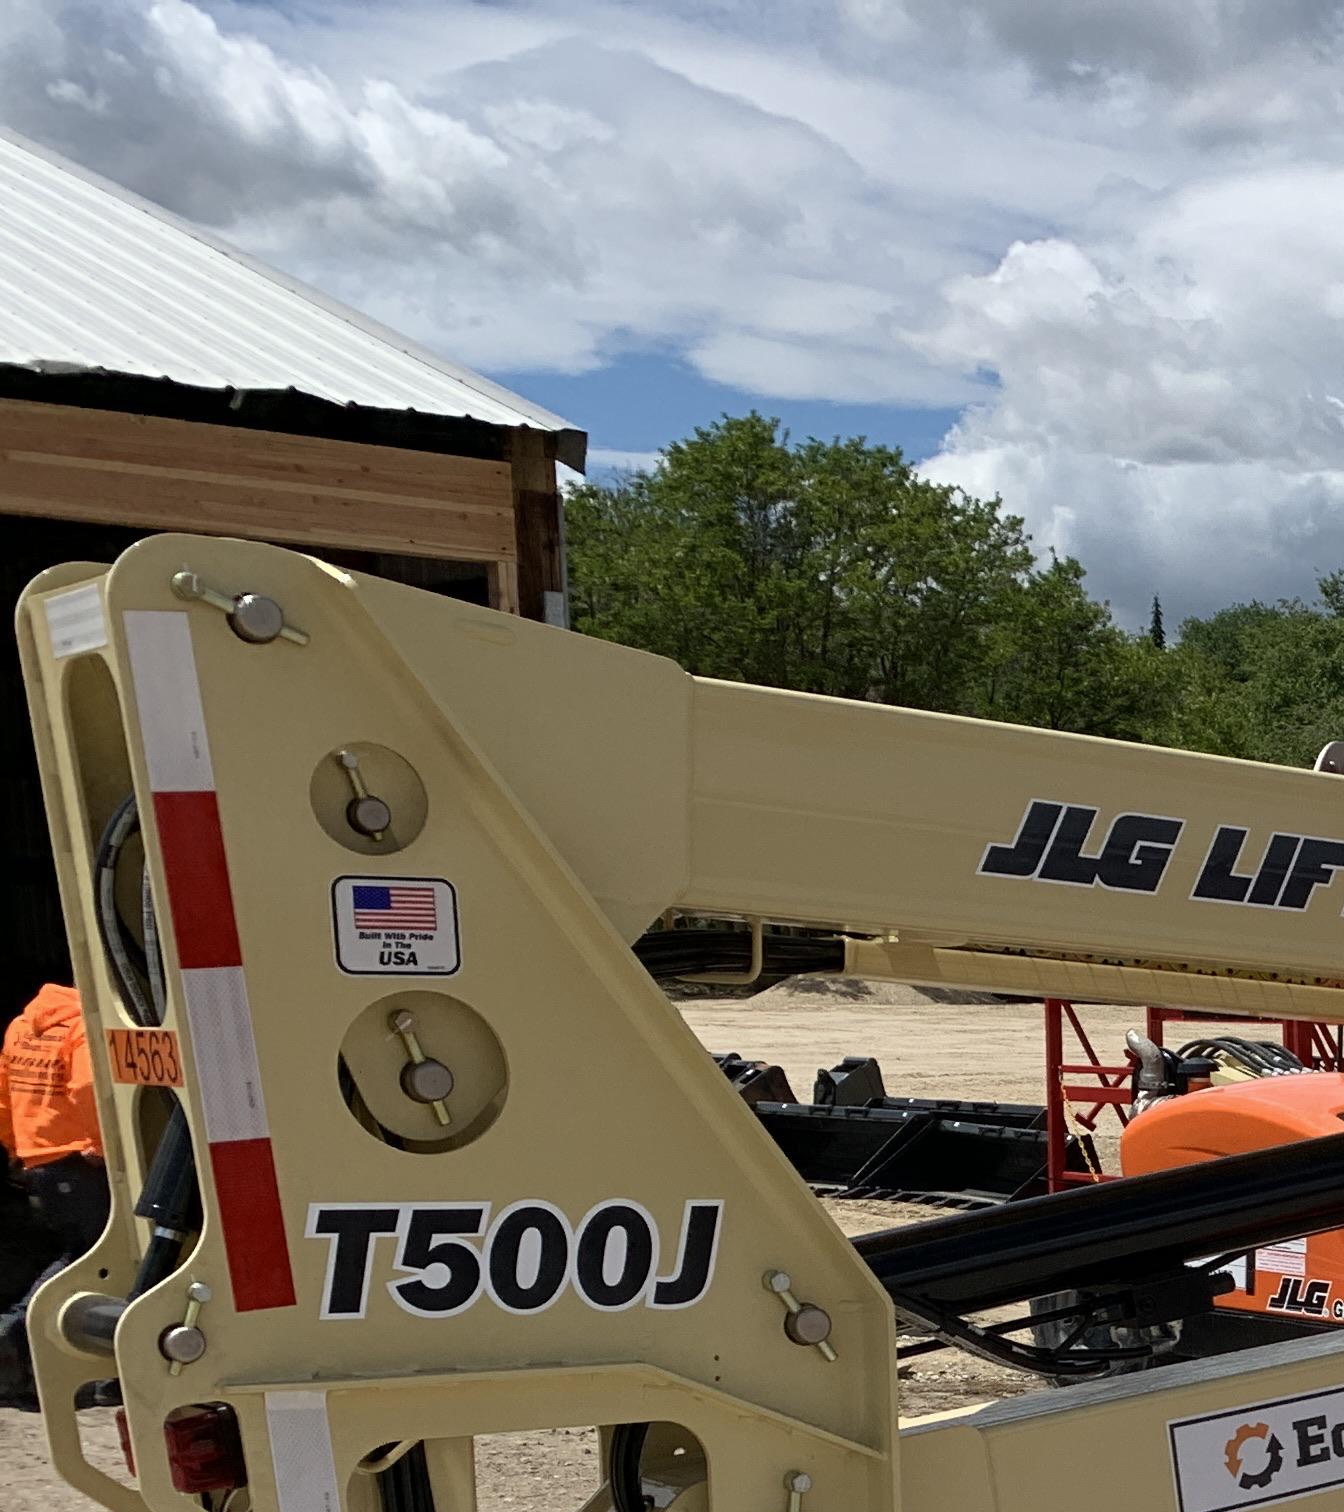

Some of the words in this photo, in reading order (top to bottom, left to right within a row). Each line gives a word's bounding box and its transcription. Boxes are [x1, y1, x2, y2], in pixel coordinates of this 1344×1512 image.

[977, 799, 1185, 893] JLG
[359, 932, 381, 940] Built
[385, 932, 406, 940] With
[409, 933, 433, 941] Pride
[395, 941, 411, 949] The
[379, 951, 418, 966] USA
[306, 1201, 723, 1319] T500J
[1267, 1275, 1331, 1315] JLG
